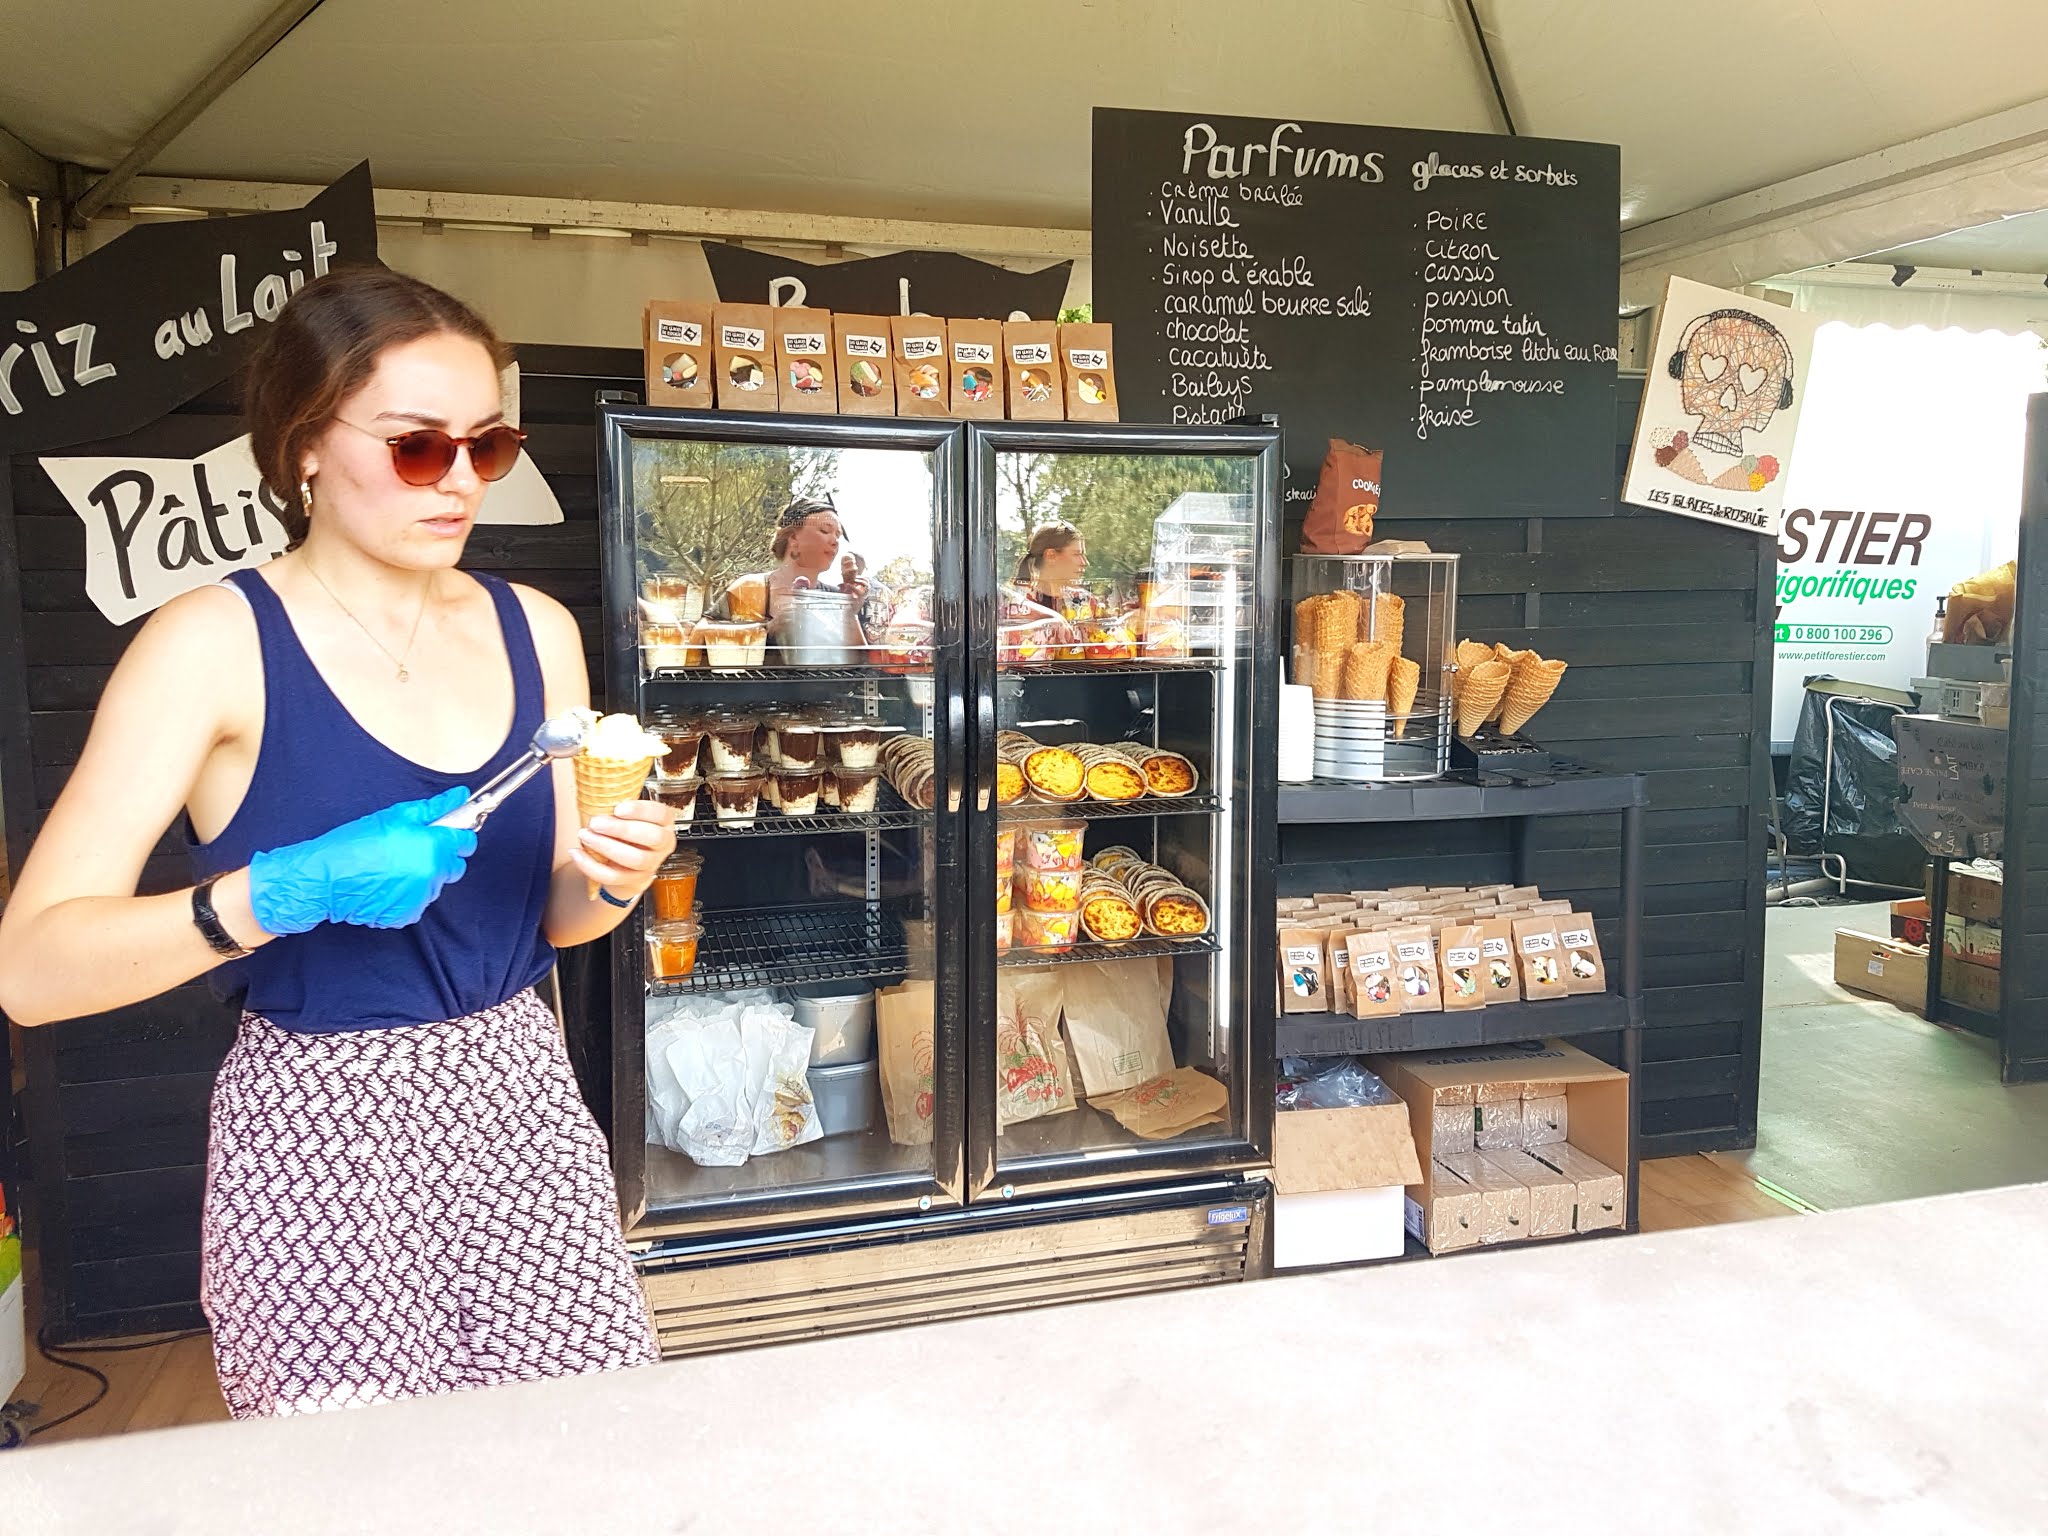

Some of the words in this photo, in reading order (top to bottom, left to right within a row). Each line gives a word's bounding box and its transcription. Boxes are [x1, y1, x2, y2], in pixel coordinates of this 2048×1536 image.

[1182, 123, 1384, 182] Parfums
[1412, 151, 1485, 191] glaces
[1489, 160, 1509, 180] et
[1514, 163, 1578, 186] sorbets
[1160, 196, 1240, 227] Vanille
[1163, 232, 1254, 259] Noisette
[1337, 285, 1372, 317] salé
[1423, 286, 1513, 319] passion
[1166, 317, 1249, 343] chocolat
[1421, 317, 1499, 344] pomme
[0, 319, 117, 415] riz
[154, 306, 213, 359] au
[1169, 344, 1273, 370] cacahuète
[1420, 338, 1512, 378] framboise
[1521, 337, 1561, 361] litchi
[1172, 371, 1252, 407] Baileys
[1420, 370, 1564, 406] pamplemousse
[1417, 403, 1481, 440] fraise
[1647, 489, 1671, 504] LES
[1777, 508, 1932, 566] STIER
[1776, 568, 1917, 605] igorifiques
[1795, 628, 1803, 639] 0
[1807, 628, 1829, 640] 800
[1834, 628, 1856, 640] 100
[1859, 629, 1883, 641] 296
[1778, 651, 1886, 662] www.petitforestier.com
